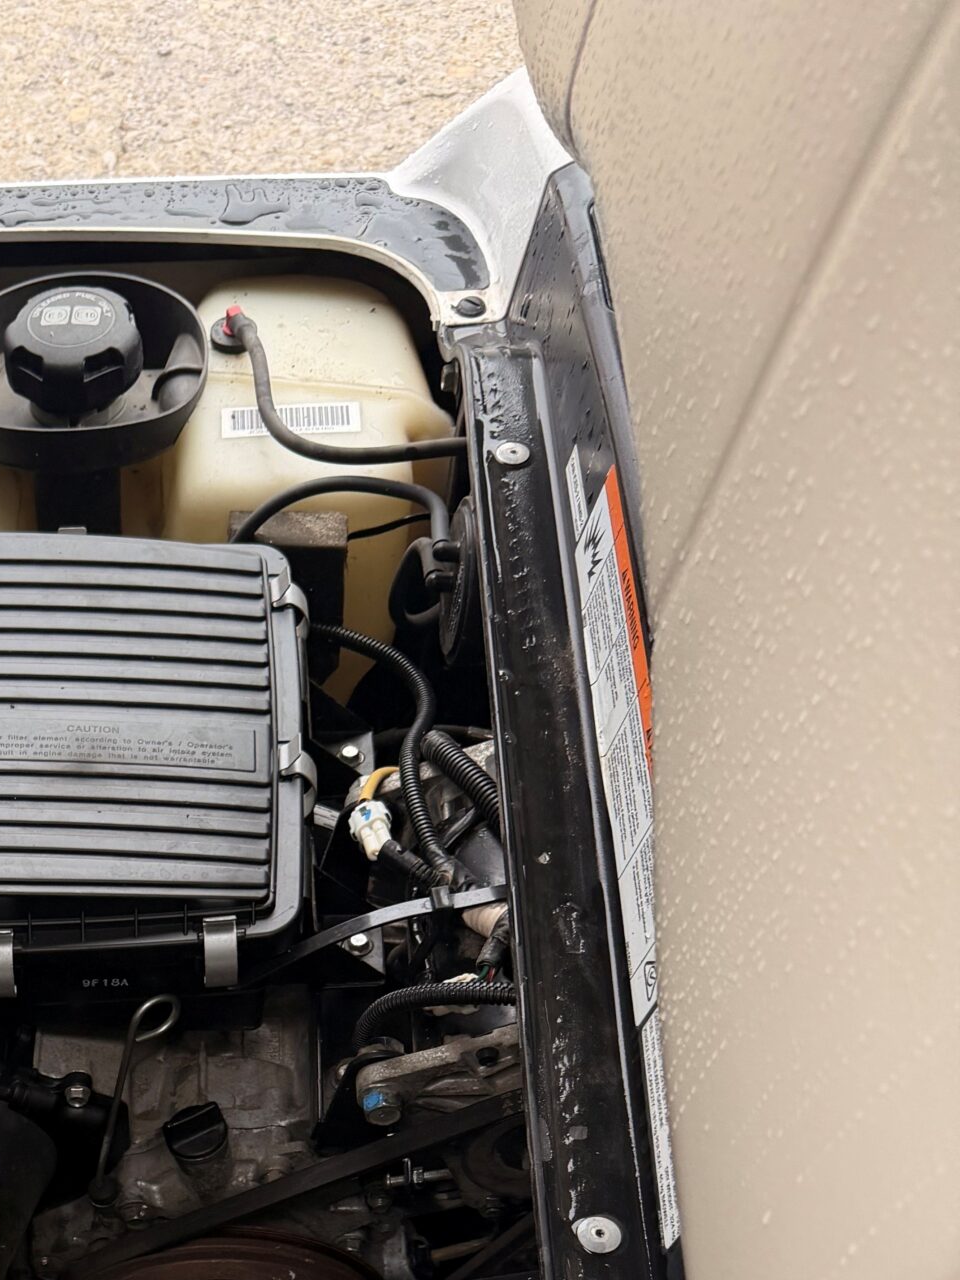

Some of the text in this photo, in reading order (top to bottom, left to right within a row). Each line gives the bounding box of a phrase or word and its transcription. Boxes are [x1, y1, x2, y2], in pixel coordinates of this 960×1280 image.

[624, 578, 639, 650] WARNING
[66, 724, 120, 734] CAUTION
[75, 736, 118, 745] according
[32, 750, 62, 758] engine
[67, 750, 103, 759] damage
[108, 752, 125, 760] that
[91, 744, 133, 752] alteration
[201, 749, 233, 758] system
